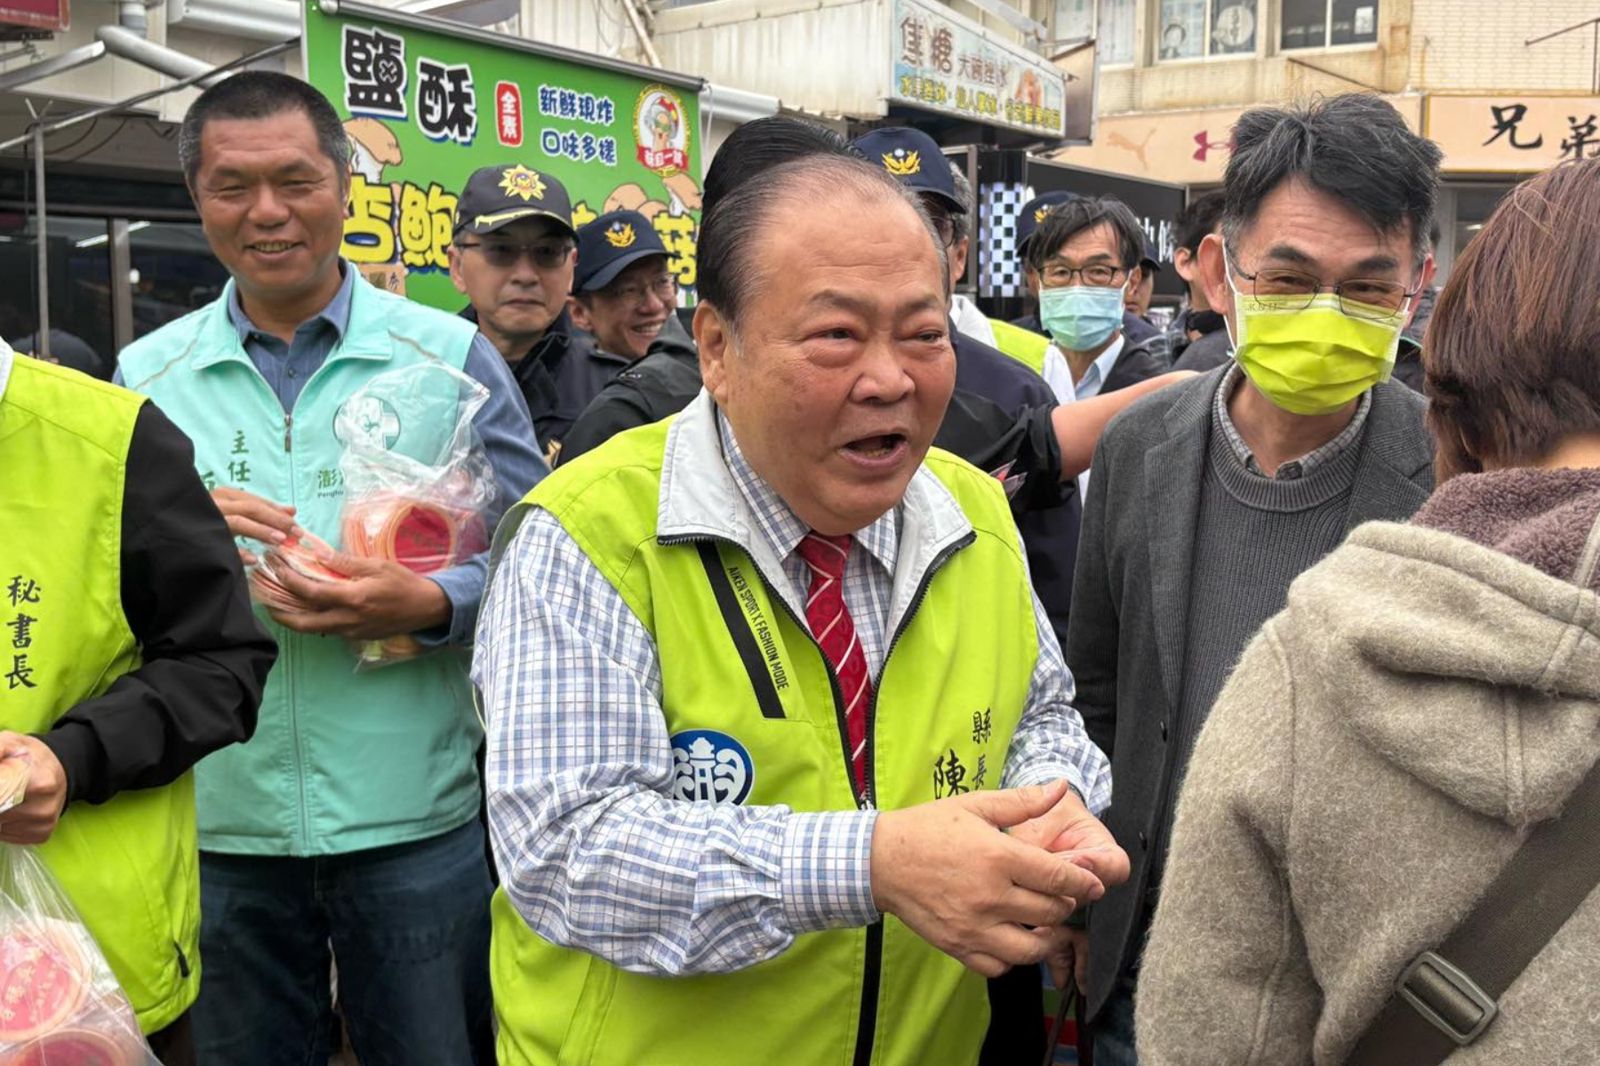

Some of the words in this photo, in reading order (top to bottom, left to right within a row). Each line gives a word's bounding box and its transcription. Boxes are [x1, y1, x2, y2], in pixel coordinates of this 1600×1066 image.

[344, 28, 476, 140] 鹽酥
[539, 86, 614, 124] 新鮮現炸
[542, 131, 616, 164] 口味多樣
[1482, 103, 1600, 162] 兄弟
[228, 430, 251, 482] 主任
[728, 565, 747, 592] AIKEN
[740, 587, 761, 616] SPORT
[751, 613, 764, 625] X
[5, 575, 41, 690] 秘書長
[756, 620, 779, 662] FASHION
[770, 661, 790, 690] MODE
[972, 707, 992, 791] 縣長
[933, 748, 970, 800] 陳
